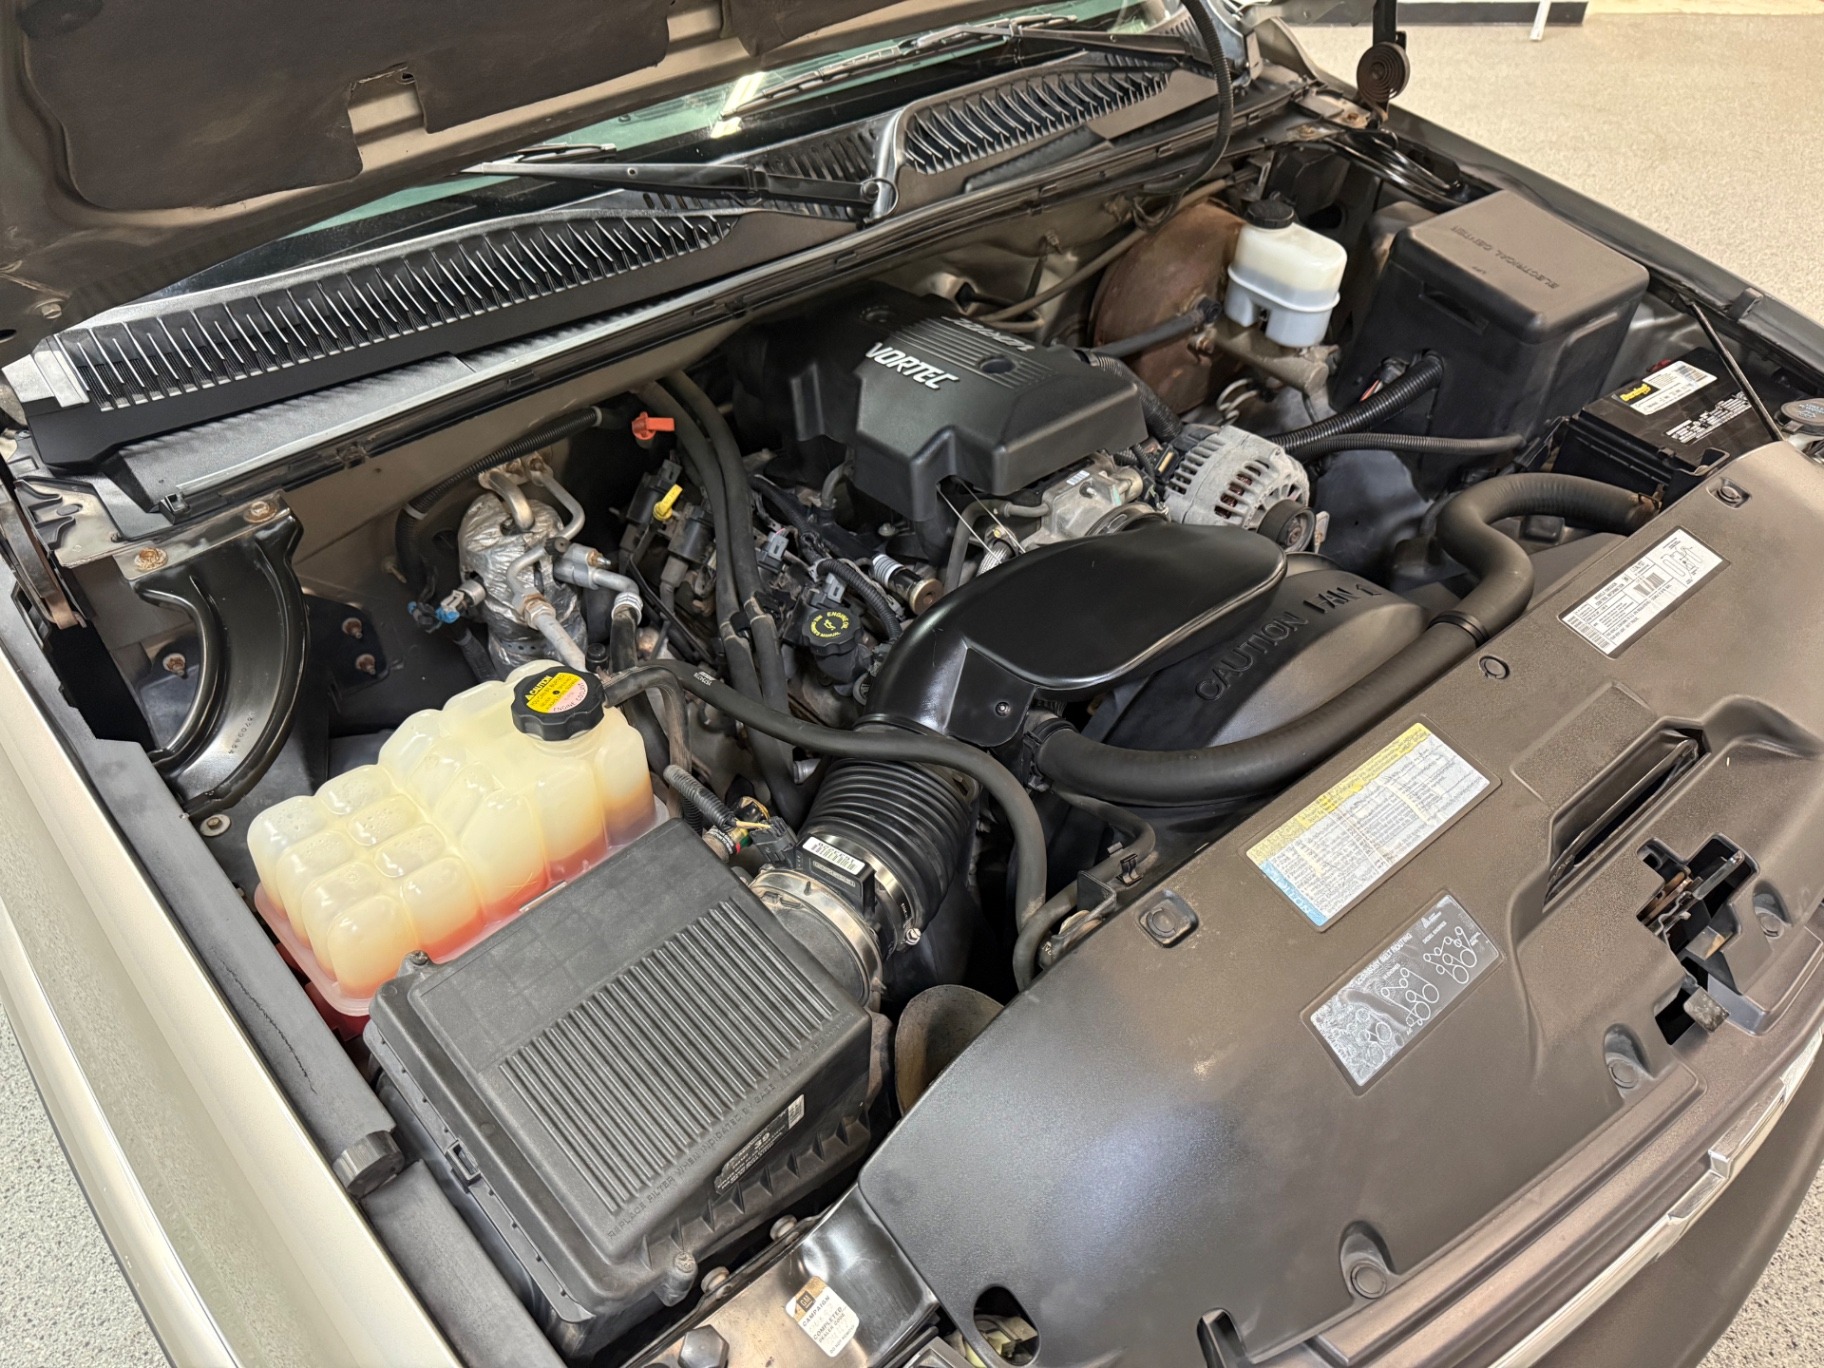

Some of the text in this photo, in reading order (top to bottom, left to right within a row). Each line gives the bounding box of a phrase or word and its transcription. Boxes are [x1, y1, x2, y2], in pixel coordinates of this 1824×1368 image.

[865, 341, 960, 389] VORTEC
[1195, 611, 1309, 701] CAUTION
[607, 1203, 647, 1239] REPLACE
[647, 1176, 676, 1203] FILTER
[676, 1156, 701, 1176] WHEN
[800, 1294, 811, 1307] GM
[802, 1295, 830, 1327] CAMPAIGN
[813, 1306, 842, 1340] COMPLETED
[819, 1325, 834, 1343] DEALER
[834, 1313, 846, 1326] CODE
